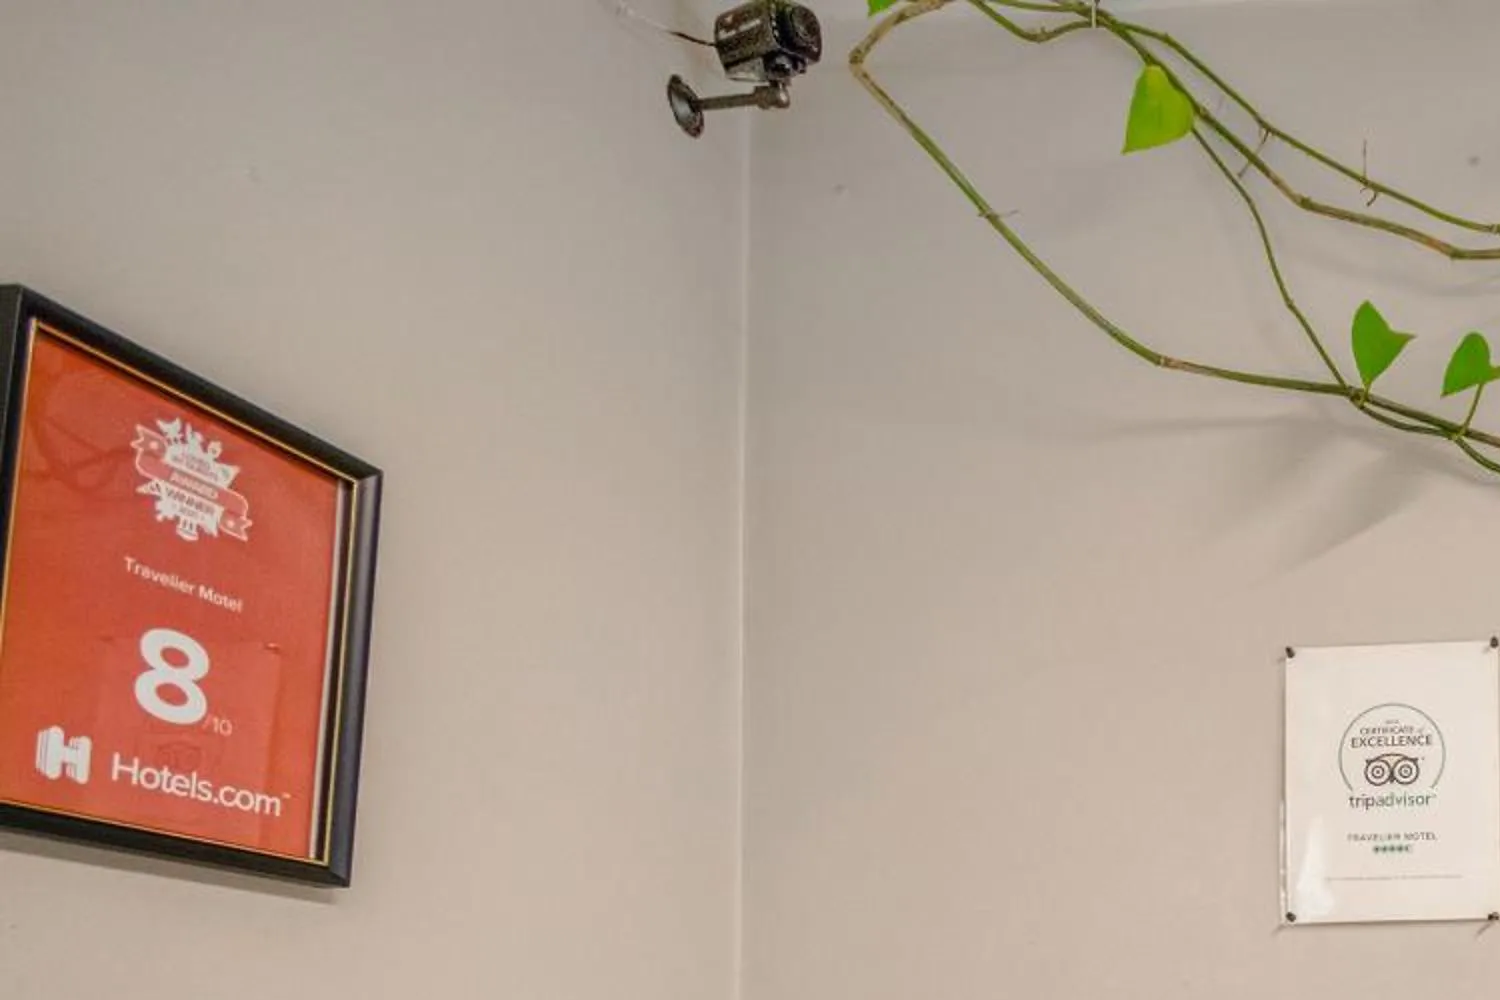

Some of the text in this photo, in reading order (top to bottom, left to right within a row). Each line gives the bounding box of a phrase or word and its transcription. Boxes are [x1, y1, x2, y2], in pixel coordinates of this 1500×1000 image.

[198, 583, 244, 613] Motel
[134, 627, 211, 725] 8
[1351, 735, 1432, 748] EXCELLENCE
[111, 751, 282, 817] Hotels.com
[1348, 791, 1431, 811] tripadvisor
[1403, 831, 1437, 841] MOTEL
